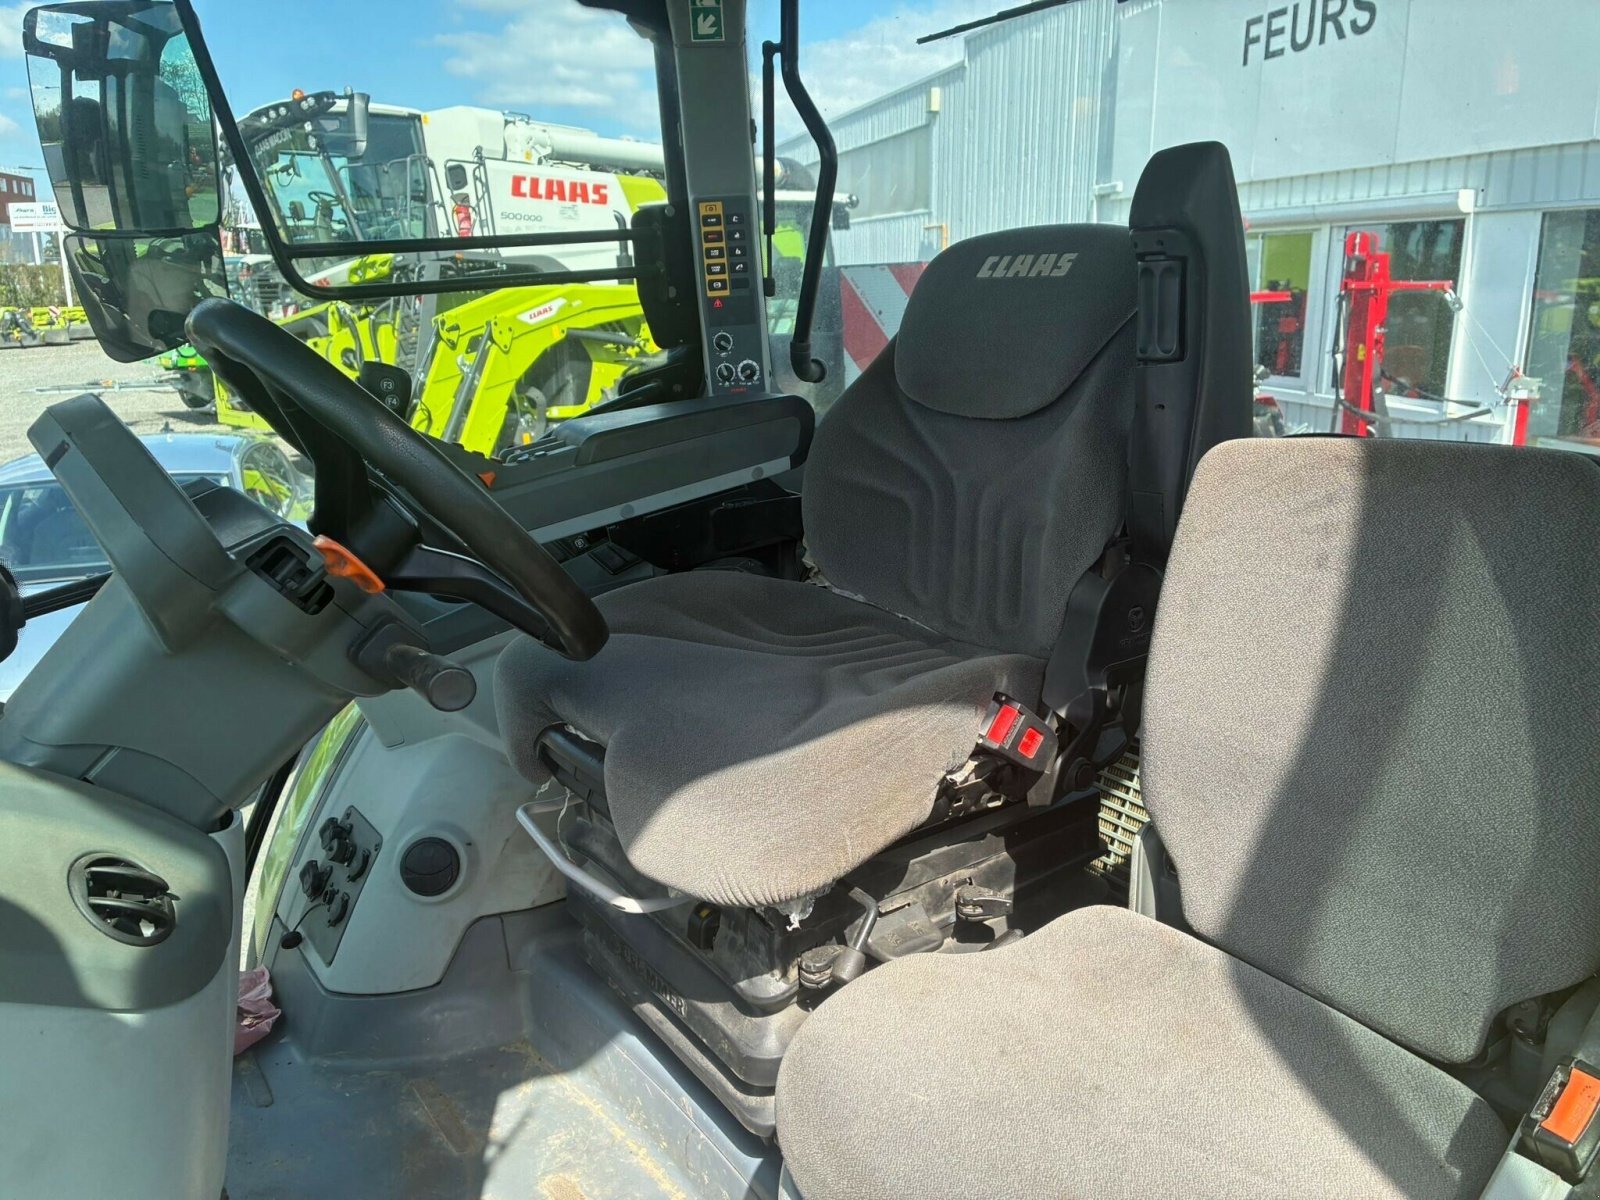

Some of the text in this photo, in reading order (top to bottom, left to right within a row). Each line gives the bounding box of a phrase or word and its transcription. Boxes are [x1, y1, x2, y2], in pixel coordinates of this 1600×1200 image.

[1242, 0, 1377, 67] FEURS
[511, 174, 608, 205] CLAAS
[976, 252, 1079, 278] CLAAS
[528, 304, 552, 320] CLAAS
[383, 381, 393, 390] F3
[387, 397, 397, 406] F4
